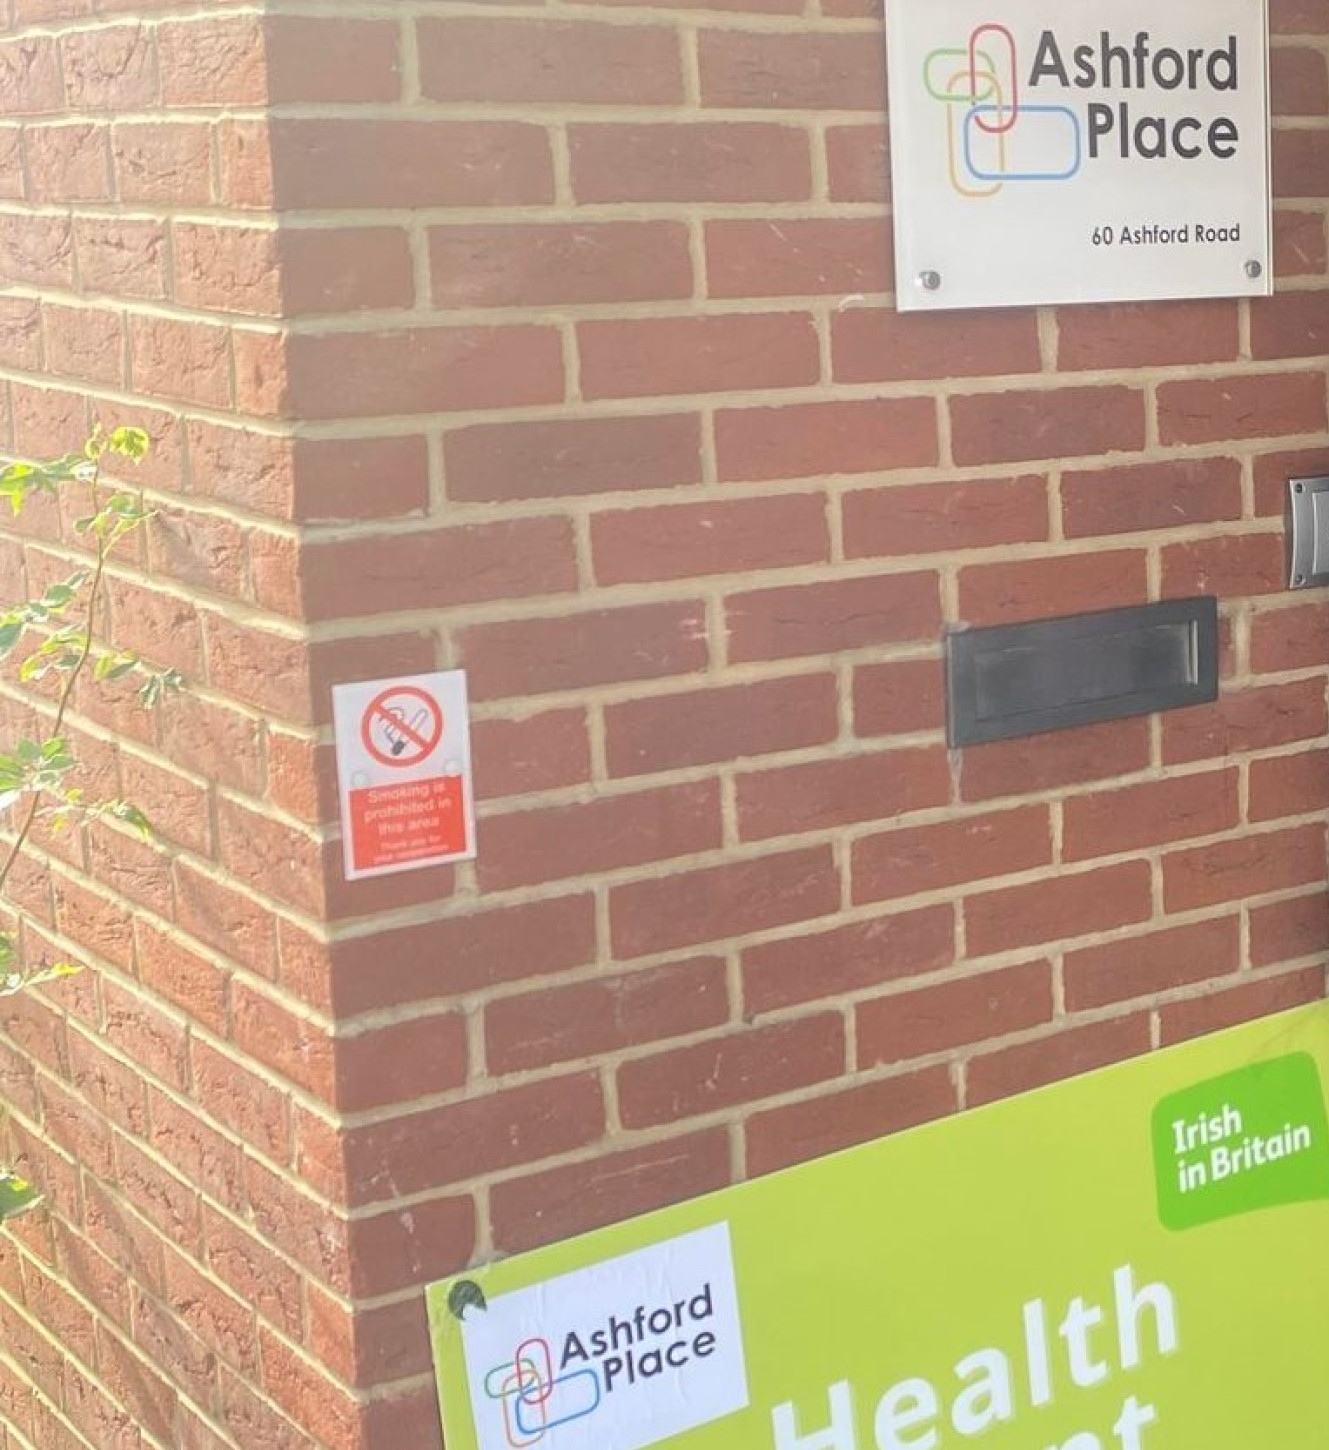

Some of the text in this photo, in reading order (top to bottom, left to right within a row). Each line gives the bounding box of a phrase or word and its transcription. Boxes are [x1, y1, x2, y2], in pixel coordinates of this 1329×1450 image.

[1028, 30, 1238, 90] Ashford
[1087, 102, 1239, 159] Place
[1092, 223, 1240, 246] 60 Ashford Road
[364, 798, 452, 824] prohibited in
[368, 783, 445, 803] Smoking is
[378, 817, 440, 836] this area
[1172, 1104, 1242, 1155] Irish
[1178, 1123, 1311, 1194] in Britain
[560, 1283, 713, 1369] Ashford
[603, 1331, 716, 1393] Place
[771, 1264, 1177, 1450] Health
